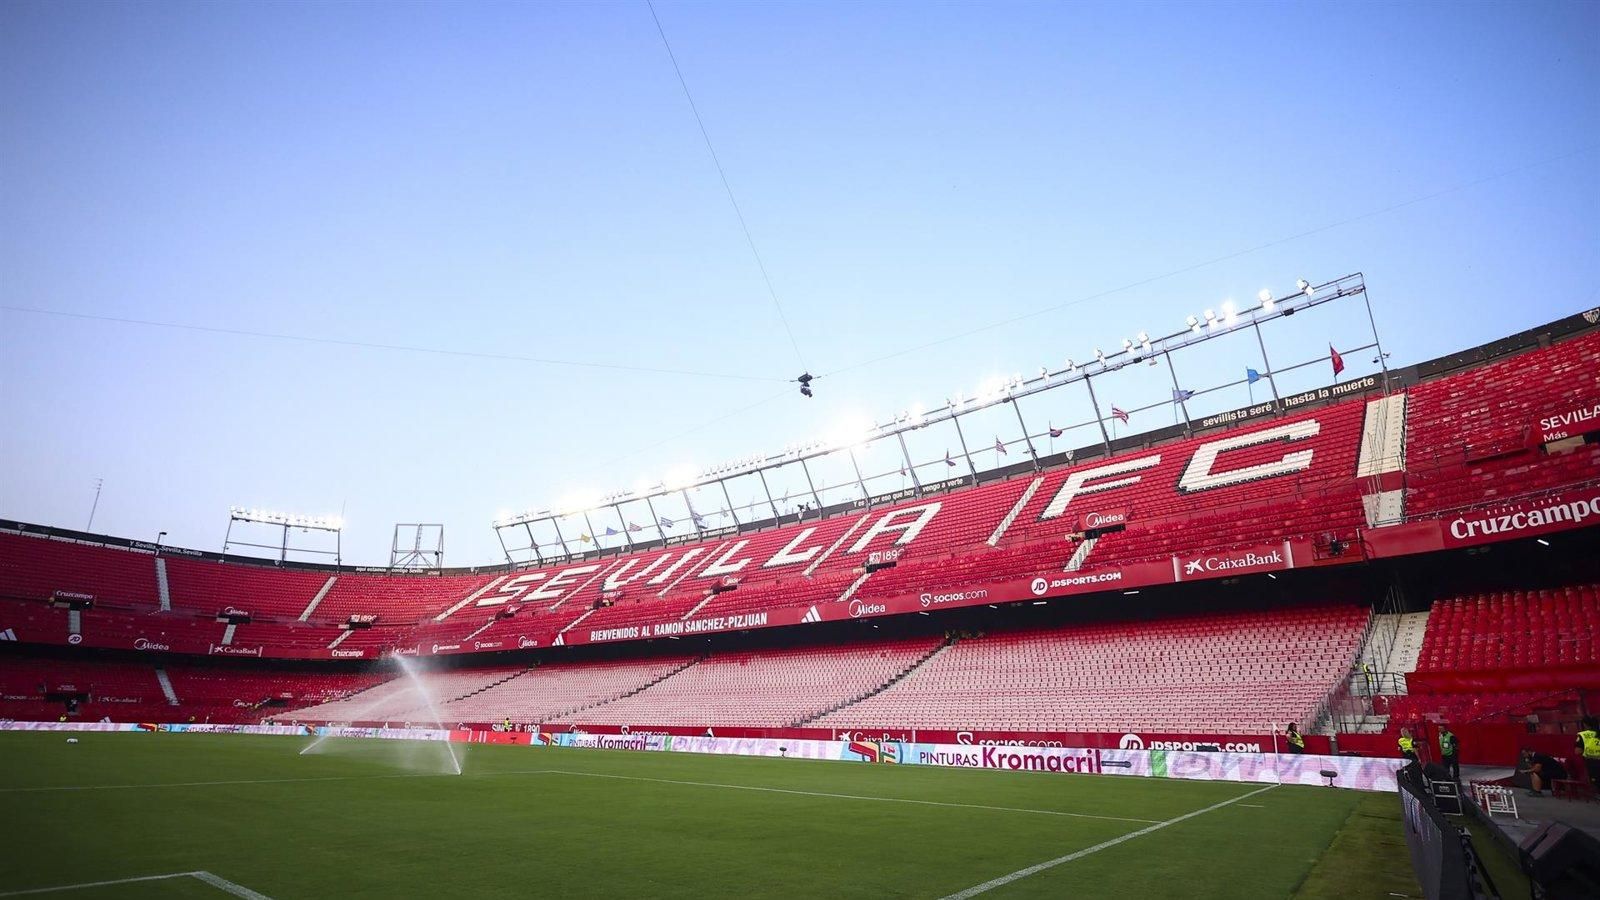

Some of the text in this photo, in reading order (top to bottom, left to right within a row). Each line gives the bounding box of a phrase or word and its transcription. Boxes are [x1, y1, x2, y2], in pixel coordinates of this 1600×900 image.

[1202, 377, 1375, 427] sevillista seré hasta la muerte
[1543, 431, 1568, 442] Más
[1085, 513, 1126, 527] Midea
[1205, 550, 1283, 571] CaixaBank
[1049, 572, 1122, 588] JDSPORTS.COM
[56, 590, 93, 600] Cruzcampo
[849, 599, 886, 617] Midea
[590, 612, 768, 641] BIENVENIDOS AL RAMON SANCHEZ-PIZJUAN
[134, 638, 169, 651] Midea
[597, 735, 647, 751] Kromacril
[919, 746, 1103, 774] PINTURAS Kromacril
